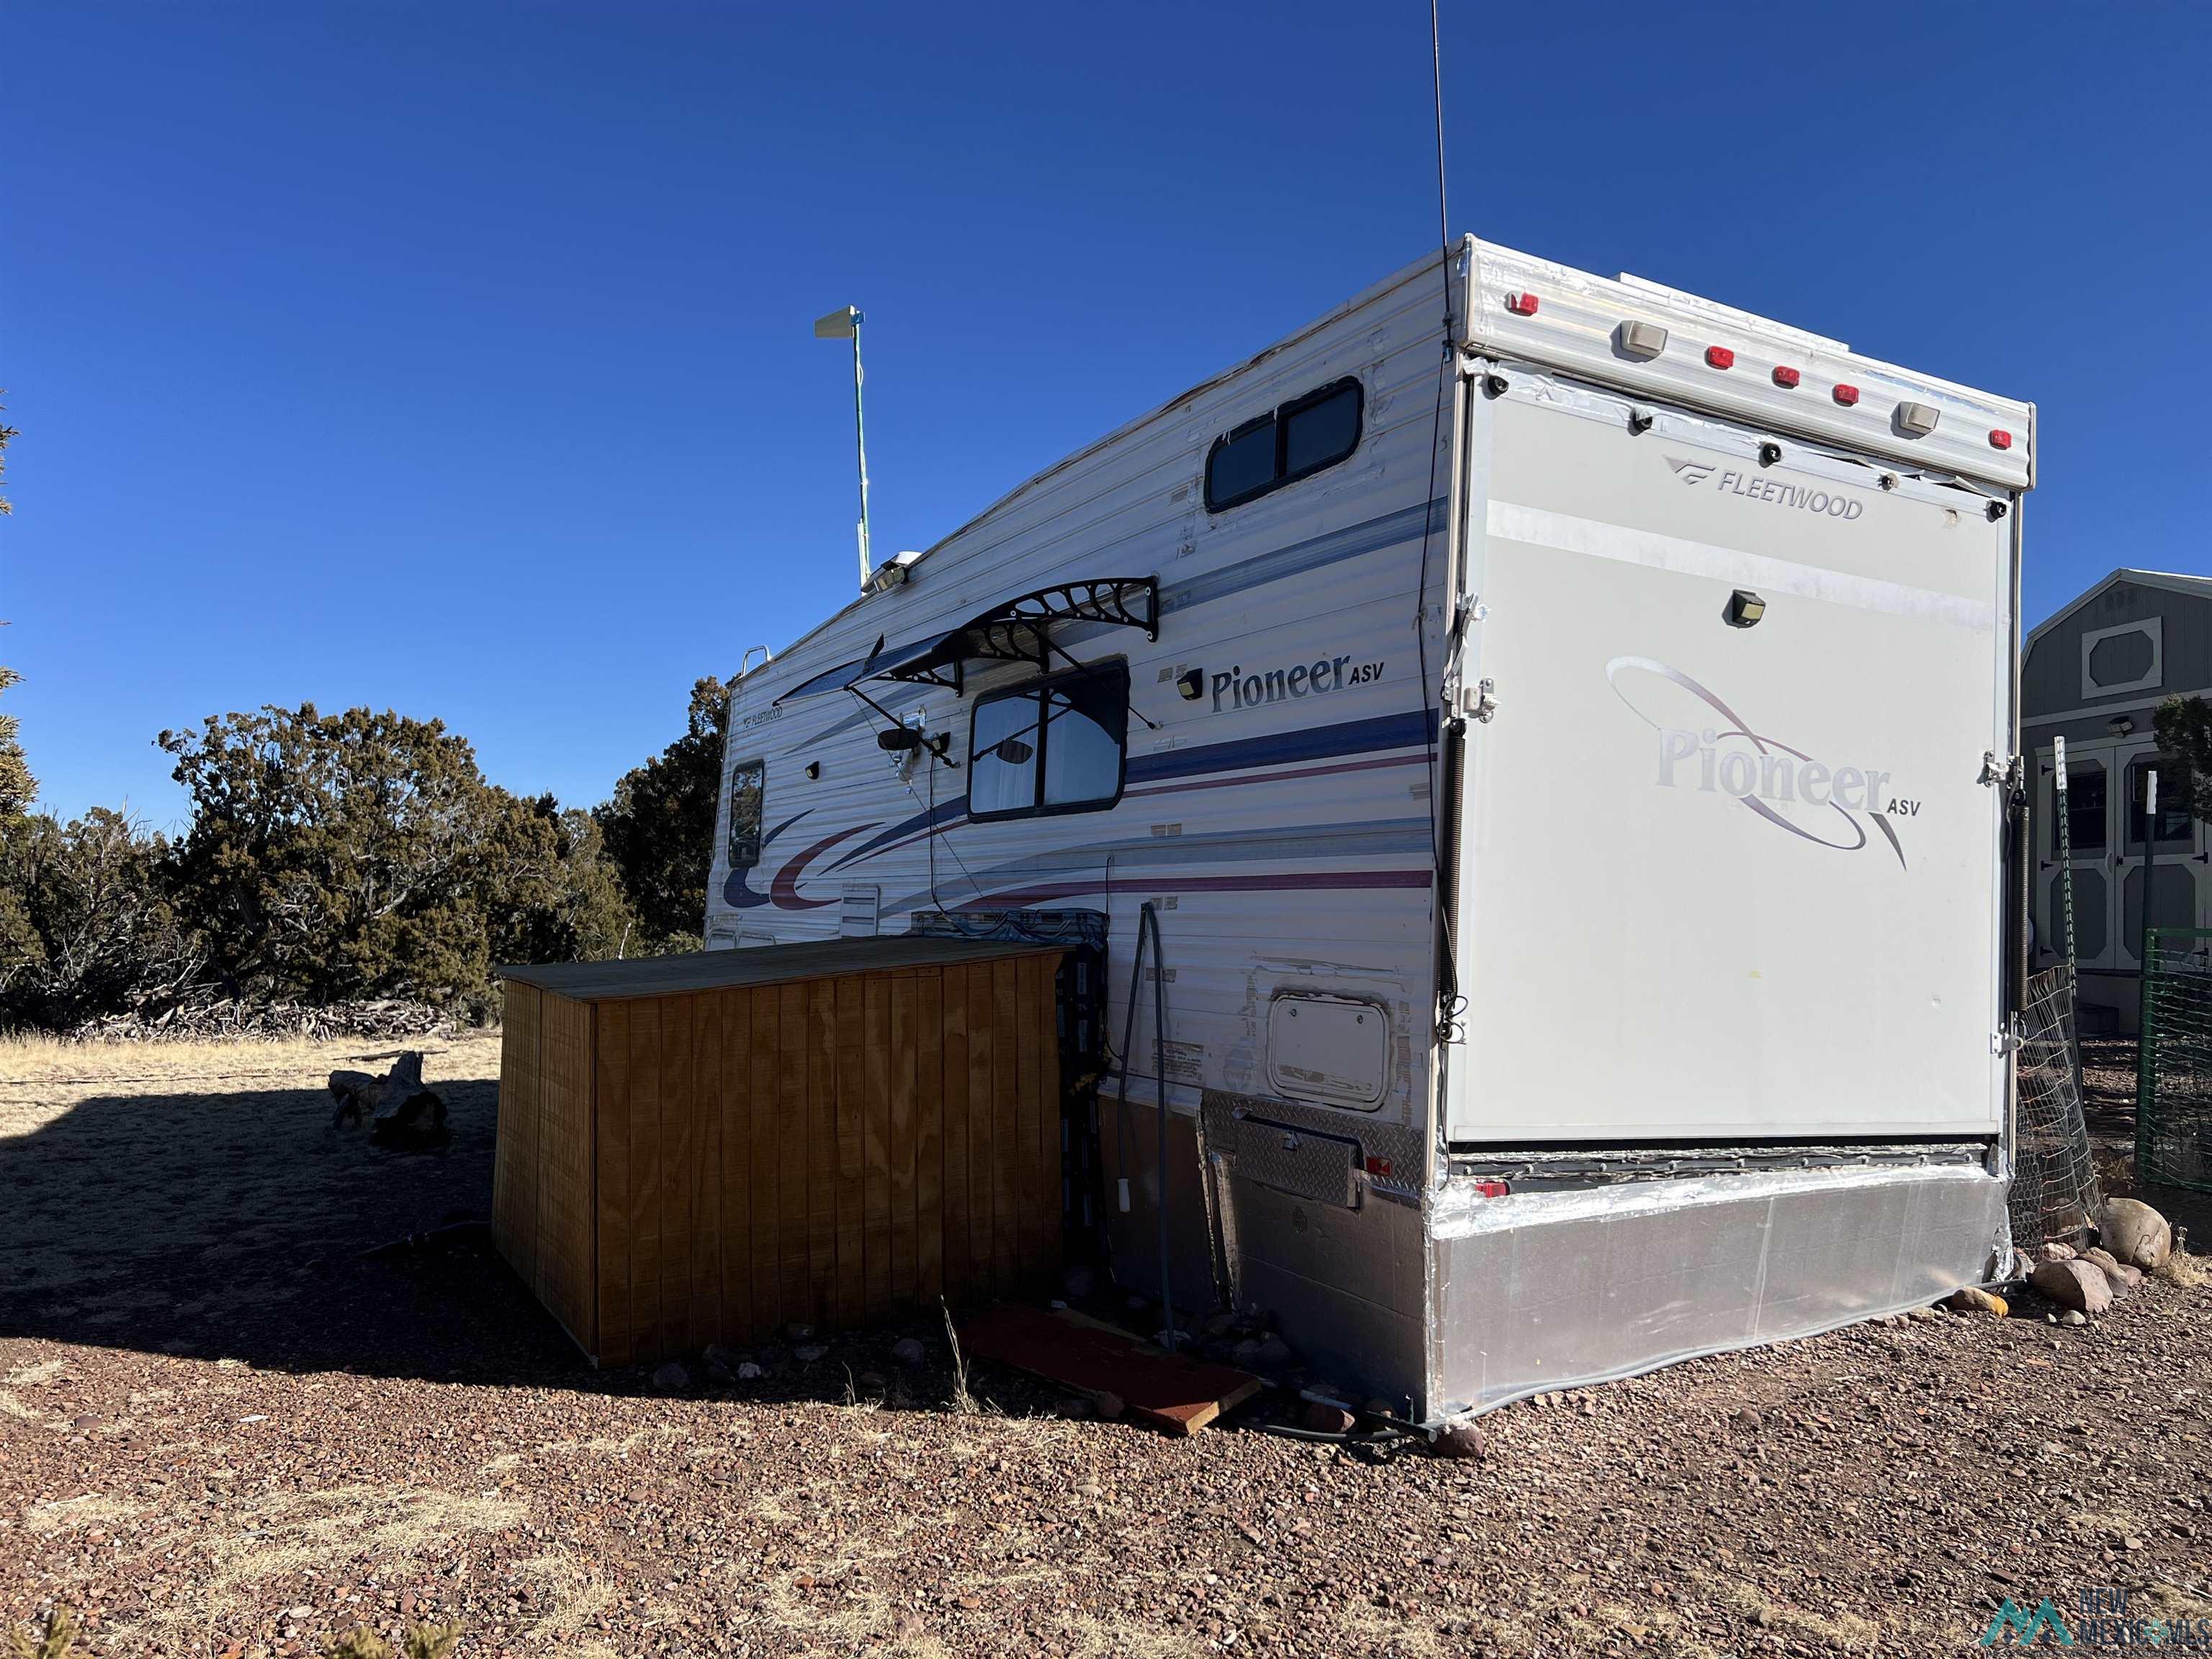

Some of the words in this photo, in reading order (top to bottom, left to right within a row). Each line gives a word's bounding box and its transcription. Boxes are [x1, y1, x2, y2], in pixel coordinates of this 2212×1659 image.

[1717, 470, 1863, 521] FLEETWOOD
[1210, 655, 1351, 713] Pioneer
[1348, 662, 1385, 685] ASV
[752, 706, 783, 725] FLEETWOOD
[1655, 727, 1891, 812] Pioneer
[1887, 797, 1921, 817] ASV
